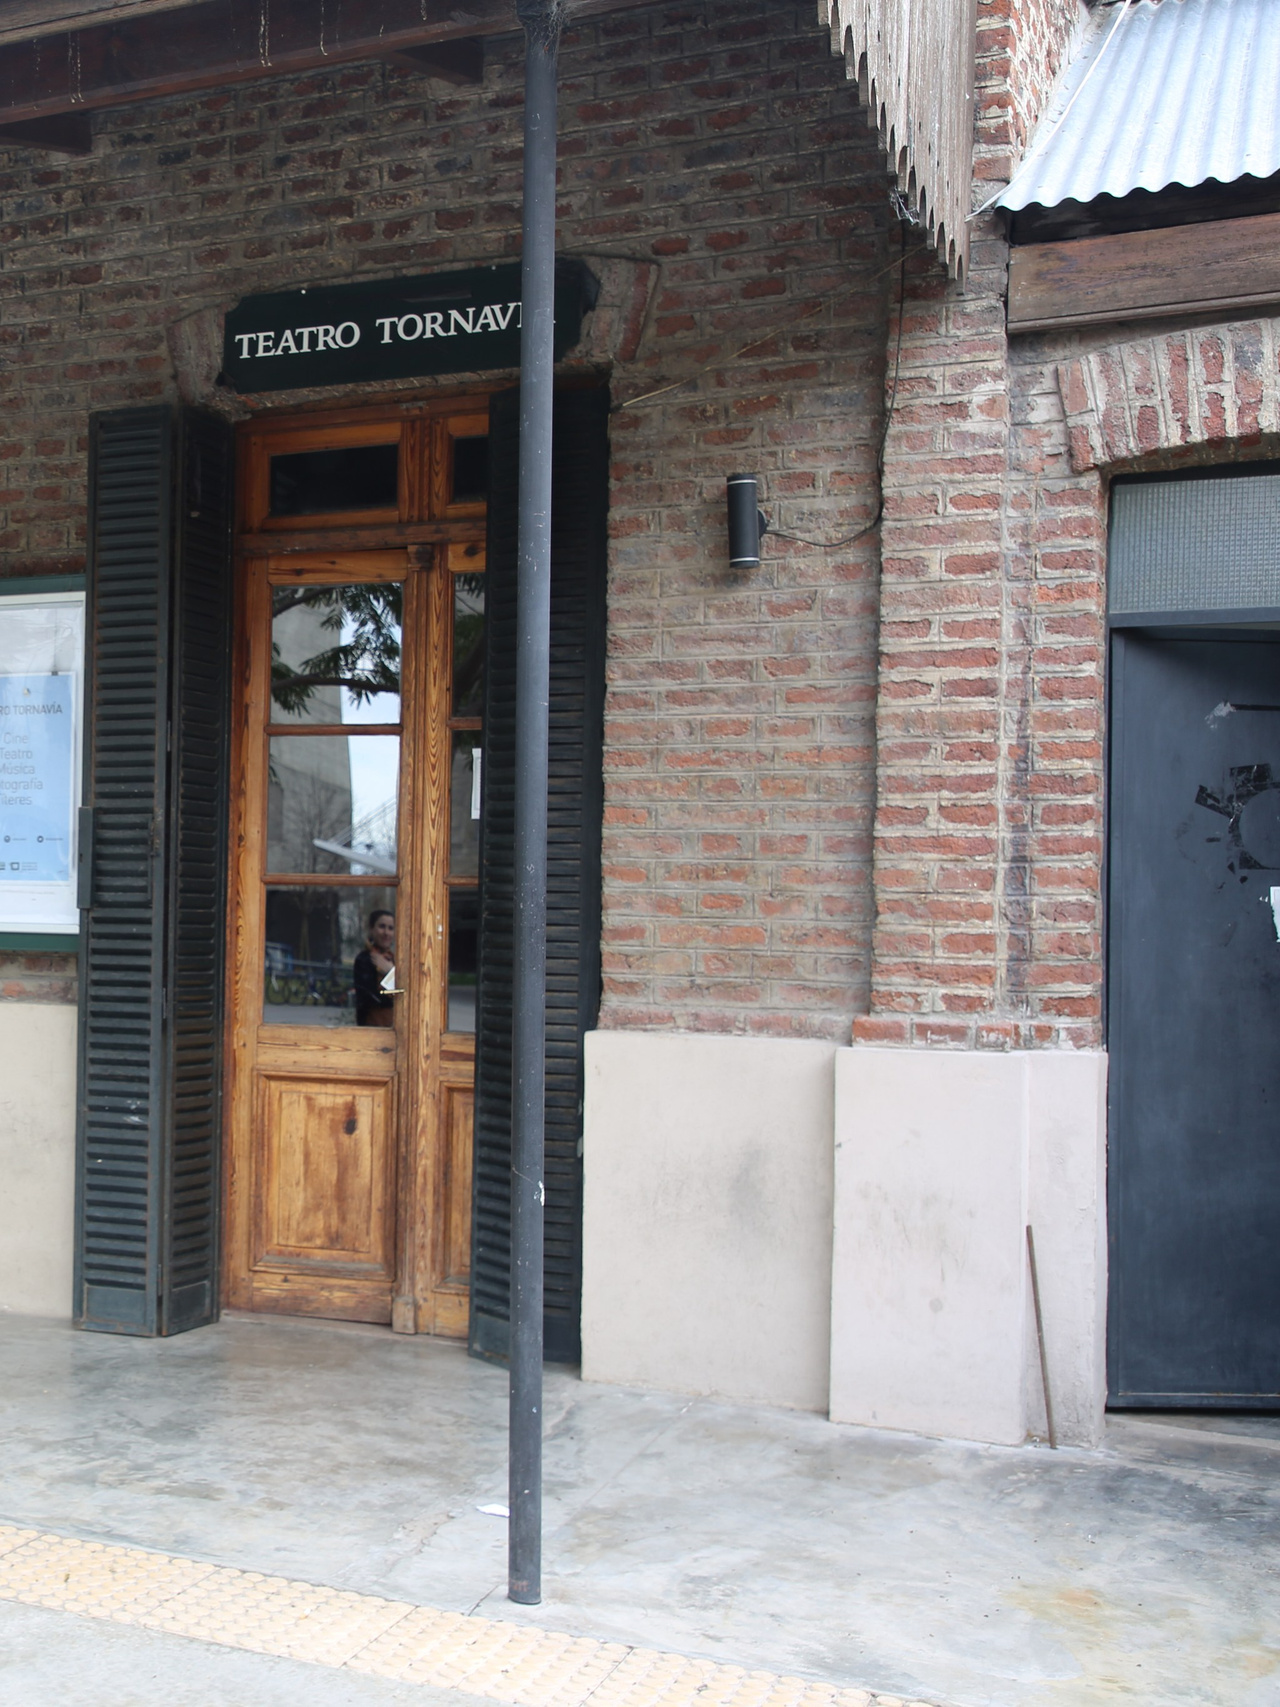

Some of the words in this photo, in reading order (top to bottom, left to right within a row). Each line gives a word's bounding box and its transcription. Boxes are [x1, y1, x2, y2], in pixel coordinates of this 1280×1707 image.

[235, 321, 360, 359] TEATRO
[375, 302, 556, 343] TORNAV
[13, 702, 63, 715] TORNAVÍA
[3, 732, 28, 744] Cine
[0, 747, 33, 760] Teatro
